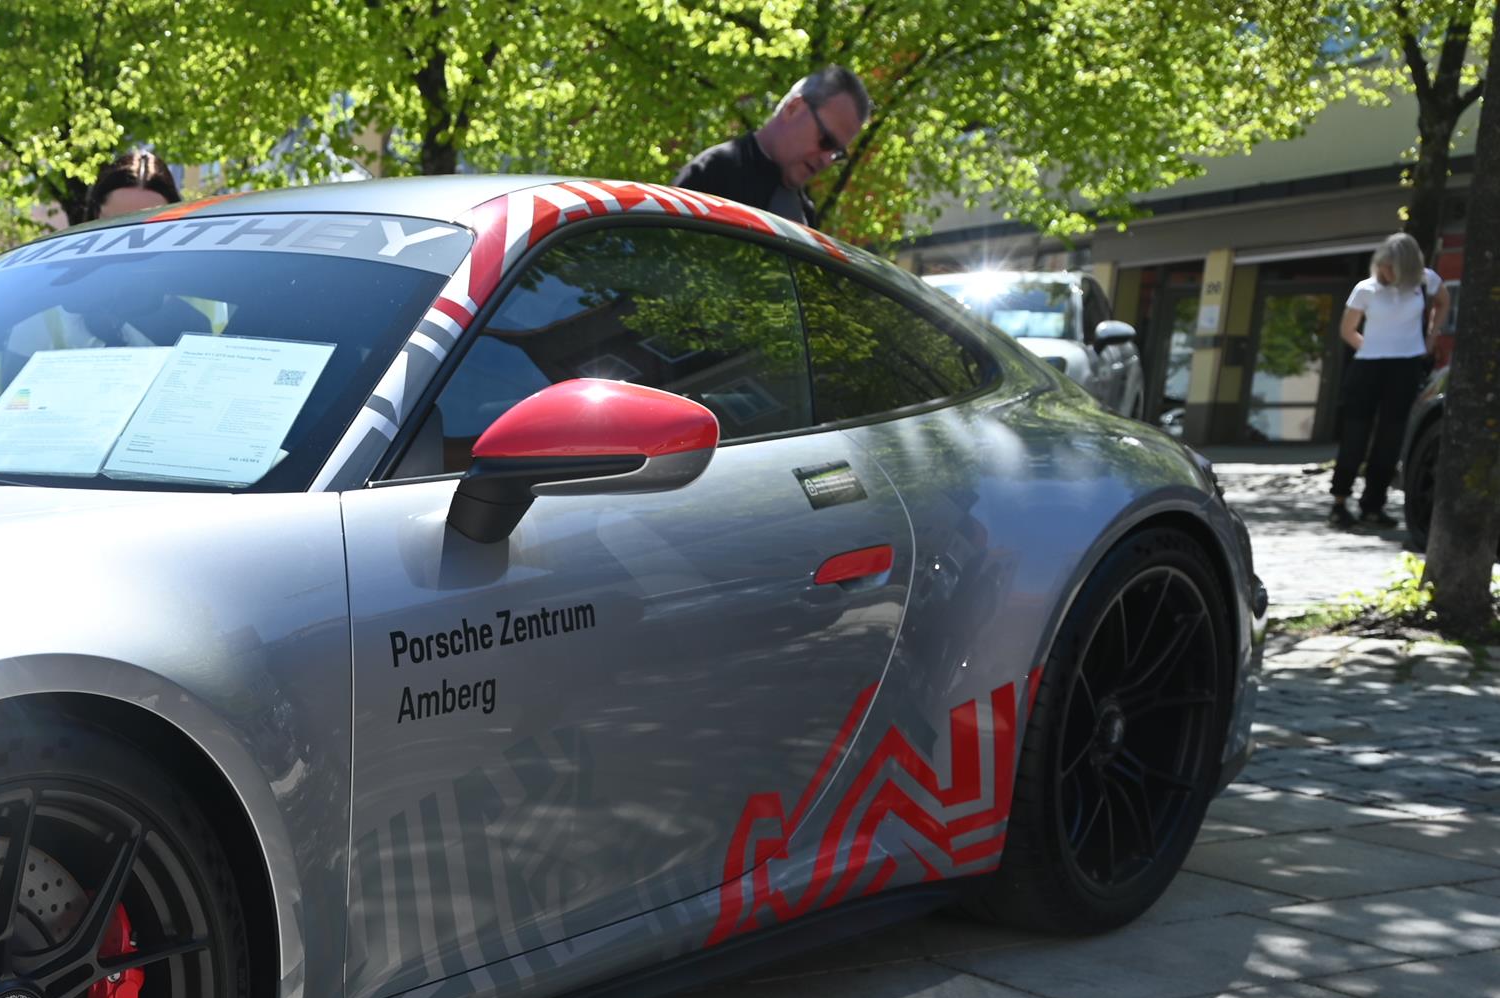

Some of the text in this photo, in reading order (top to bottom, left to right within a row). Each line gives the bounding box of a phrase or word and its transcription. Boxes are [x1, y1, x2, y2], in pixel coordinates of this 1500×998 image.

[389, 602, 596, 668] Porsche Zentrum
[397, 674, 497, 724] Amberg
